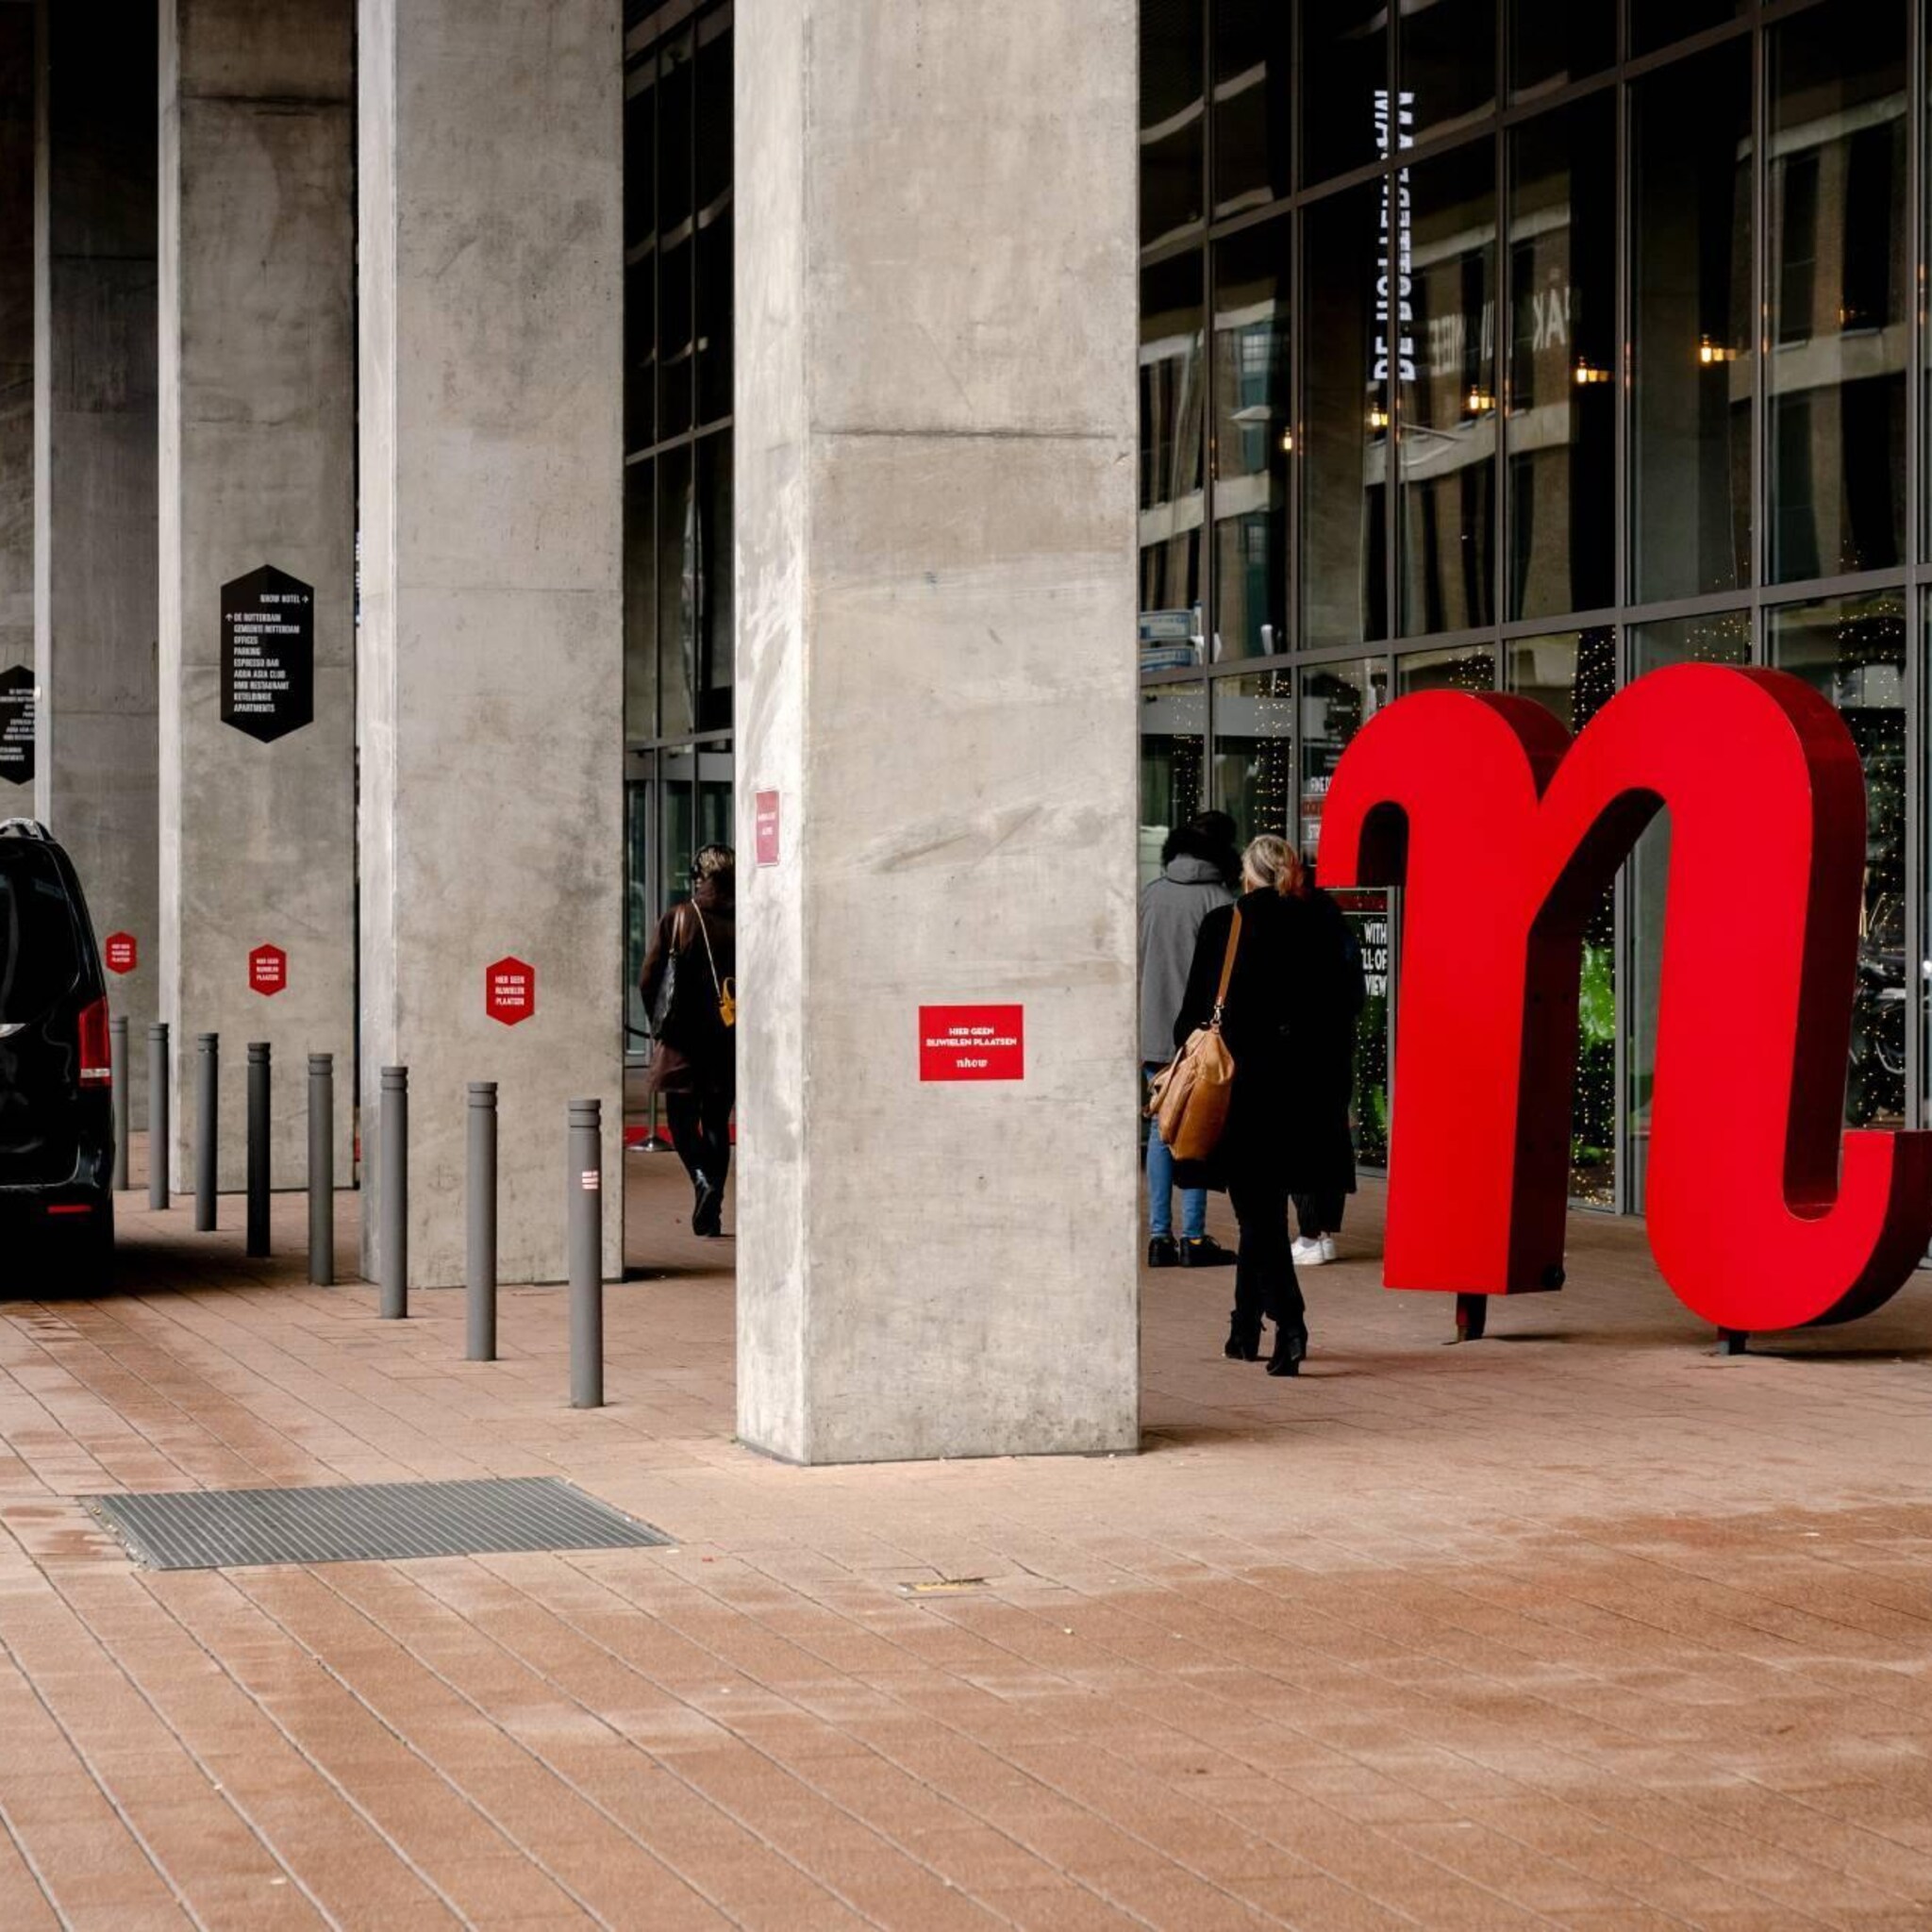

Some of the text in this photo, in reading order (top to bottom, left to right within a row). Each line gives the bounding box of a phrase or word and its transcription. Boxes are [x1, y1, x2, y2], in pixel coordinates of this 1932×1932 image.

[234, 613, 281, 623] DE ROTTERDAM
[264, 625, 300, 634] ROTTERDAM
[234, 636, 258, 644] OFFICES
[234, 647, 261, 656] PARKING
[1364, 923, 1388, 944] WITH
[949, 1027, 994, 1036] HIER GEEN
[974, 1038, 1017, 1046] PLAATSEN
[956, 1058, 988, 1068] nhow
